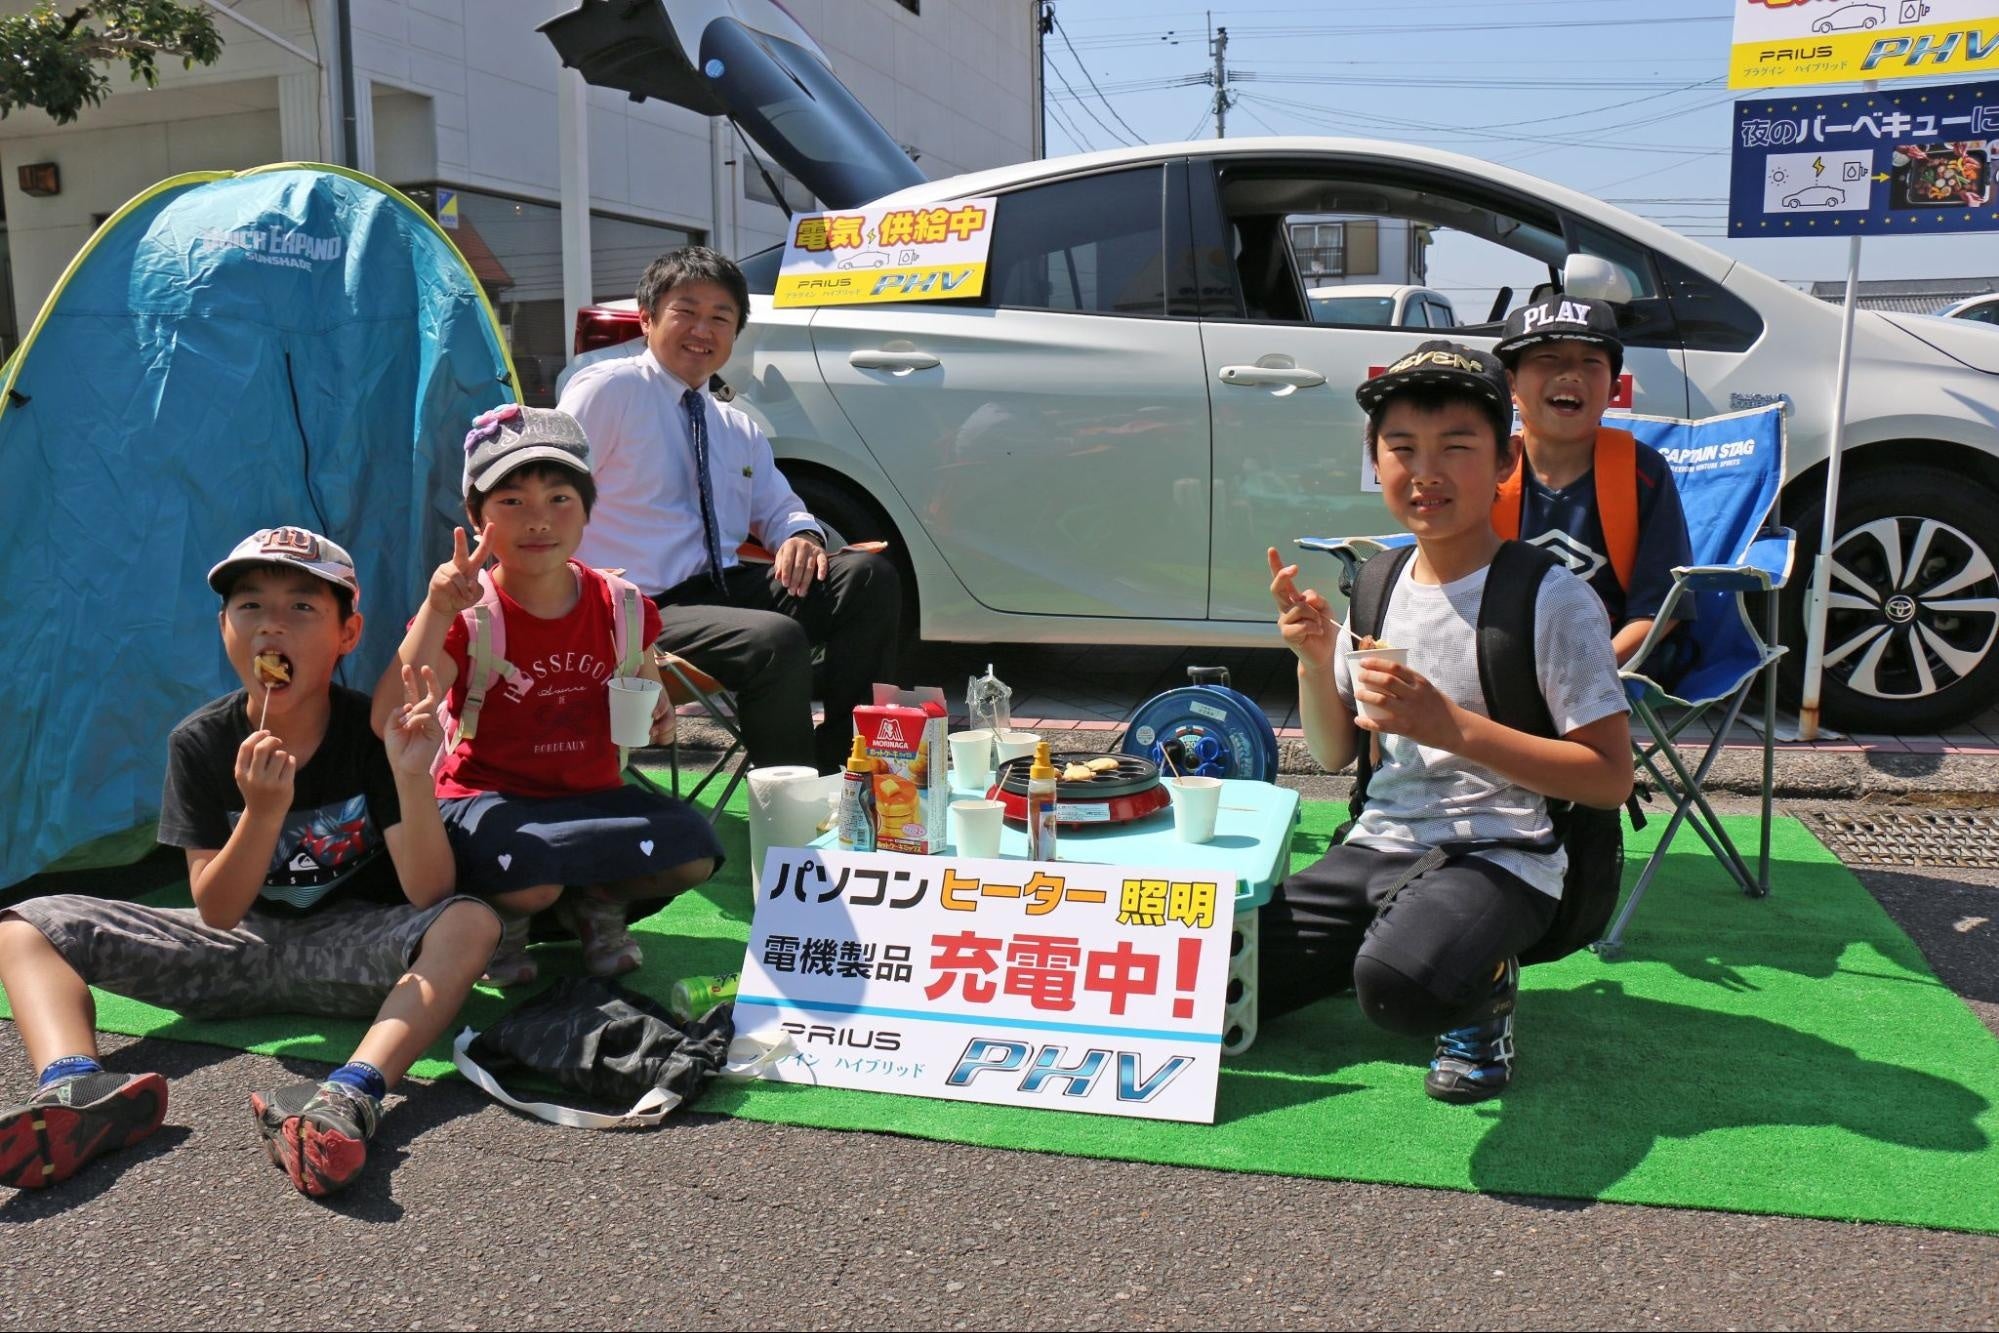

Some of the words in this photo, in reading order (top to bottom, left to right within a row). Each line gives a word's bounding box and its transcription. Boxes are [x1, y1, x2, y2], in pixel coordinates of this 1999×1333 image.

[1759, 45, 1833, 63] PRIUS
[1860, 30, 1999, 70] PHV
[1741, 105, 1999, 147] 夜のバーベキューに
[794, 216, 866, 252] 電気
[878, 205, 987, 248] 供給中
[246, 251, 313, 272] SUNSHADE
[797, 278, 851, 289] PRIUS
[869, 269, 975, 296] PHV
[1523, 300, 1591, 334] PLAY
[1718, 439, 1756, 459] STAG
[534, 740, 585, 754] BORDEAUX
[872, 739, 909, 750] MORINAGA
[769, 859, 930, 910] パソコン
[939, 868, 1108, 917] ヒーター
[1115, 878, 1218, 929] 照明
[762, 934, 914, 984] 電機製品
[780, 1022, 902, 1052] PRIUS
[835, 1055, 927, 1079] ハイブリッド
[944, 1037, 1197, 1104] PHV
